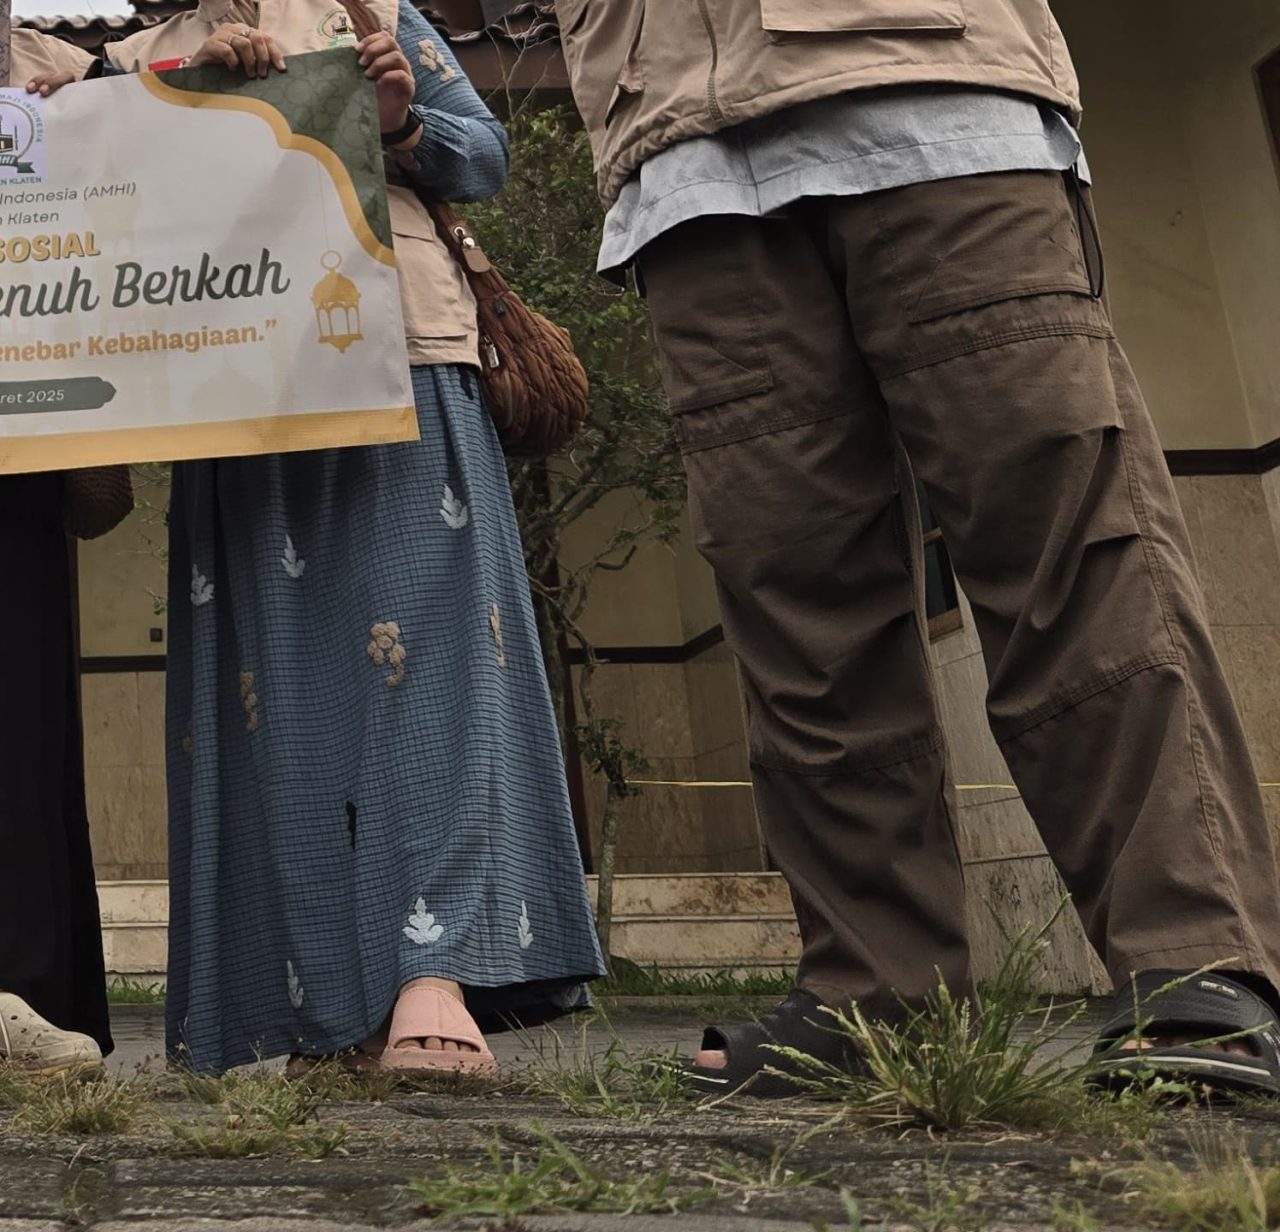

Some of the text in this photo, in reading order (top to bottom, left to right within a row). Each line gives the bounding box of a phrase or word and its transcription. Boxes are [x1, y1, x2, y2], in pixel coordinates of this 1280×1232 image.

[9, 176, 42, 185] KLATEN
[0, 188, 79, 205] Indonesia
[83, 182, 137, 201] (AMHI)
[8, 211, 60, 226] Klaten
[112, 248, 291, 308] Berkah
[26, 389, 65, 403] 2025
